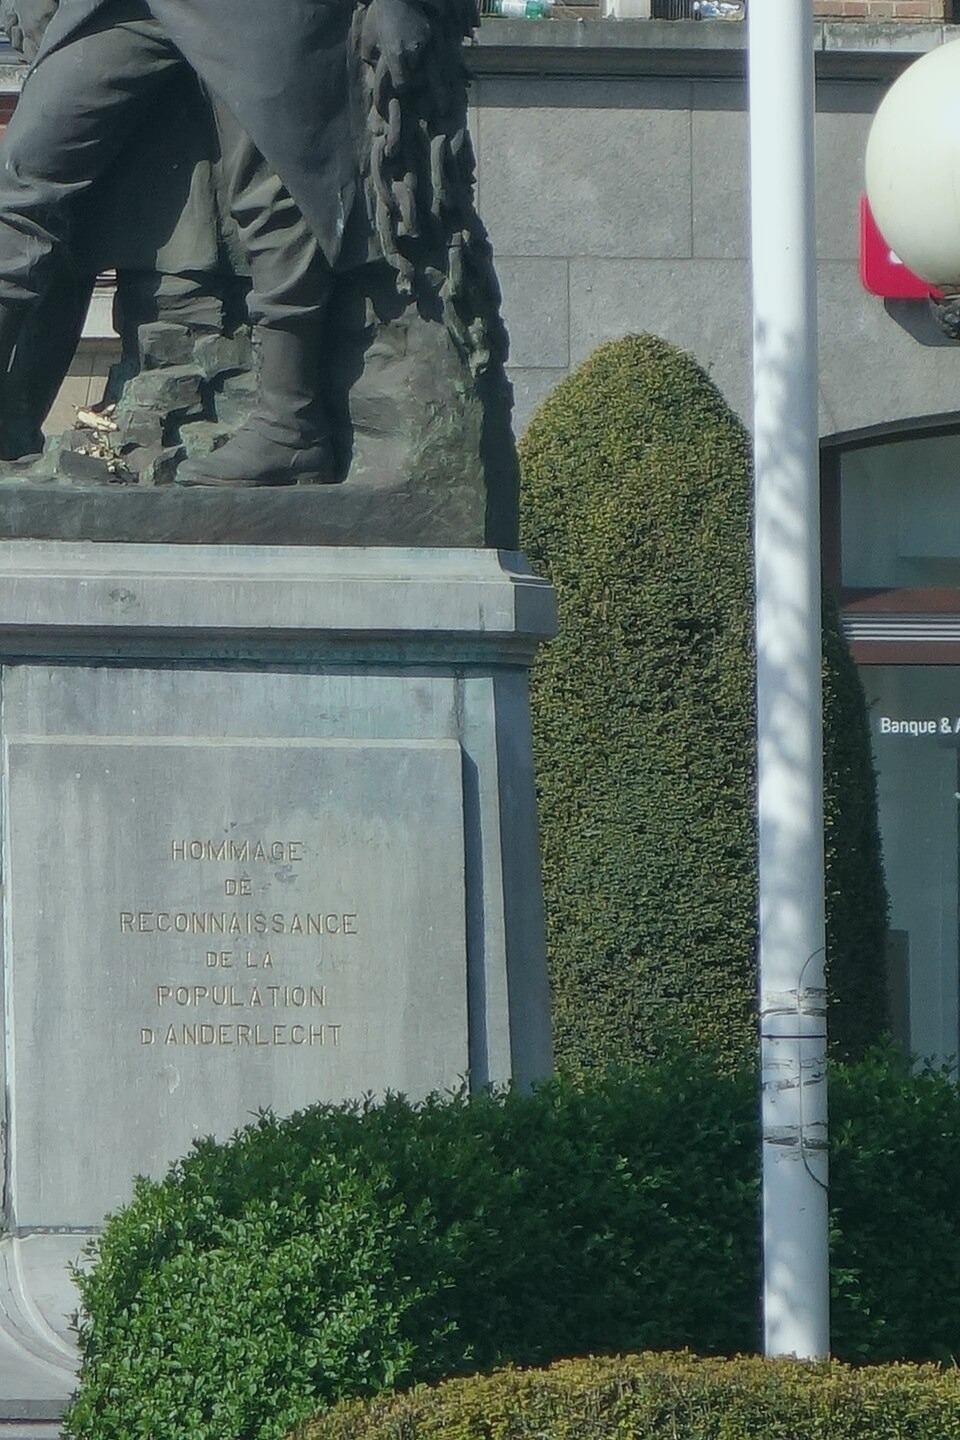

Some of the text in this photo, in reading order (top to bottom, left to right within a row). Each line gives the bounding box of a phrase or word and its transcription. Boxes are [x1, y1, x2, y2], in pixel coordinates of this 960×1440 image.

[880, 717, 937, 736] Banque
[941, 717, 952, 733] &
[171, 839, 303, 861] HOMMAGE
[225, 879, 253, 896] DE
[119, 912, 359, 935] RECONNAISSANCE
[206, 951, 273, 968] DE LA
[156, 985, 328, 1007] POPULATION
